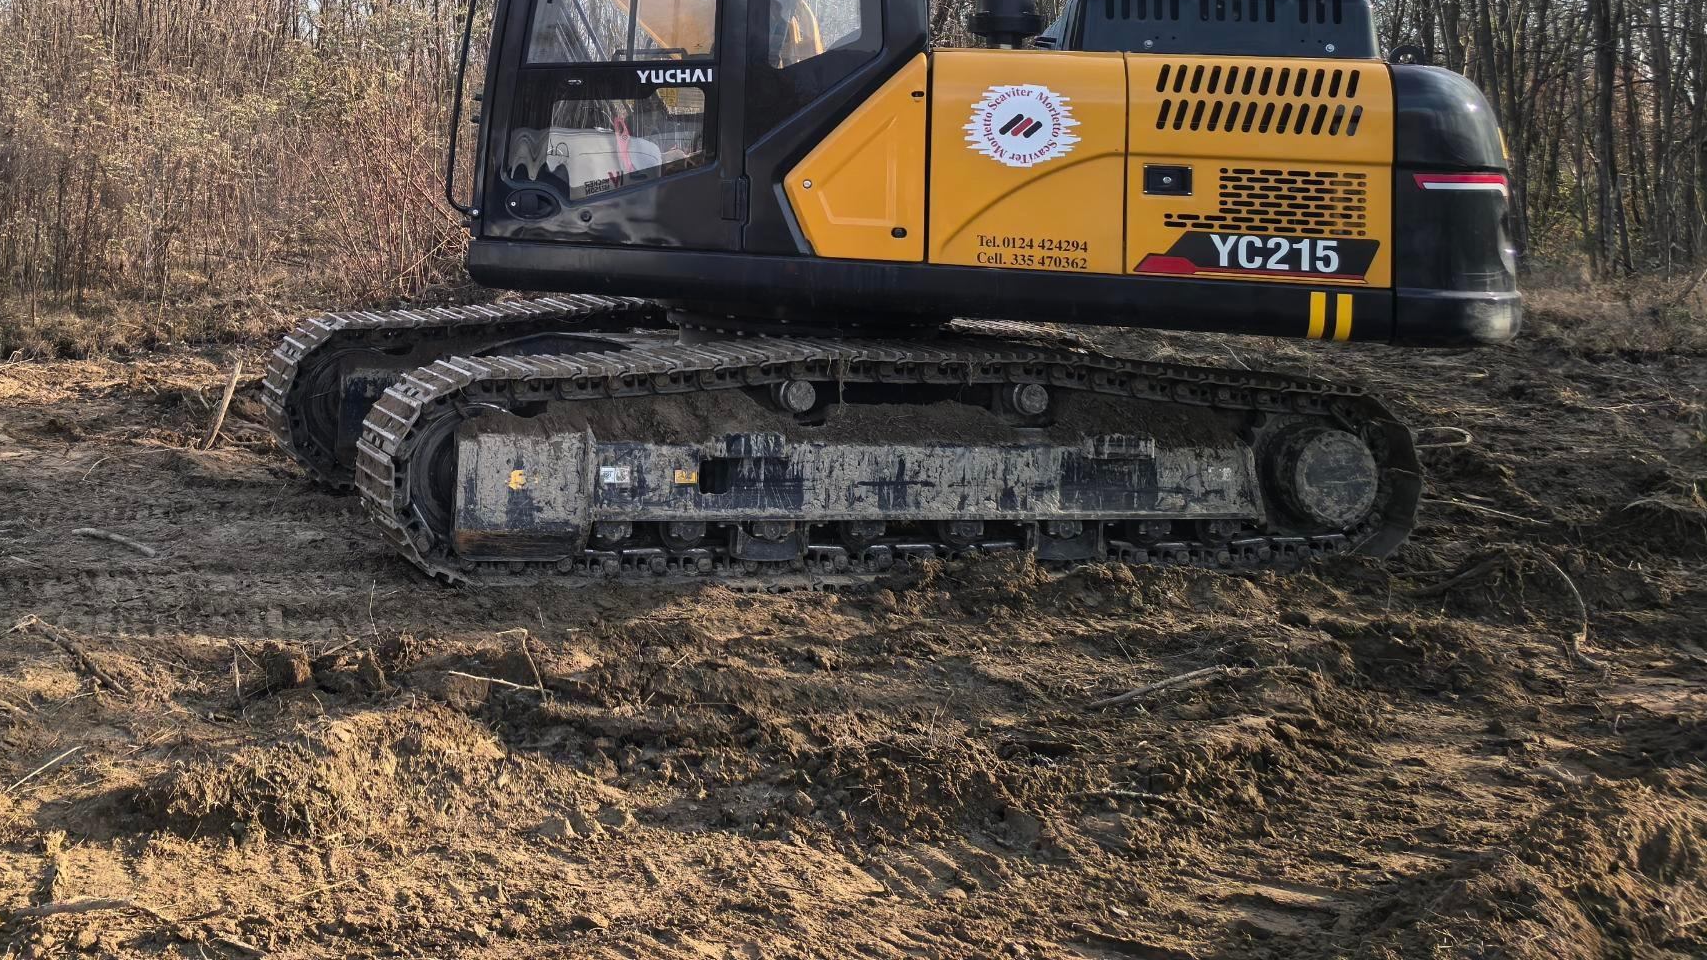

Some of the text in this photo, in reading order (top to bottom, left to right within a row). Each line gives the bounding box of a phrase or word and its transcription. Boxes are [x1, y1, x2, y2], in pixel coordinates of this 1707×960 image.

[636, 68, 713, 83] YUCHAI
[988, 87, 1033, 110] Scaviter
[1035, 92, 1061, 138] Morletto
[983, 112, 1007, 158] Morletto
[977, 235, 1088, 253] Tel. 0124 424294
[1210, 234, 1339, 273] YC215
[977, 252, 1087, 269] Cell. 335 470362
